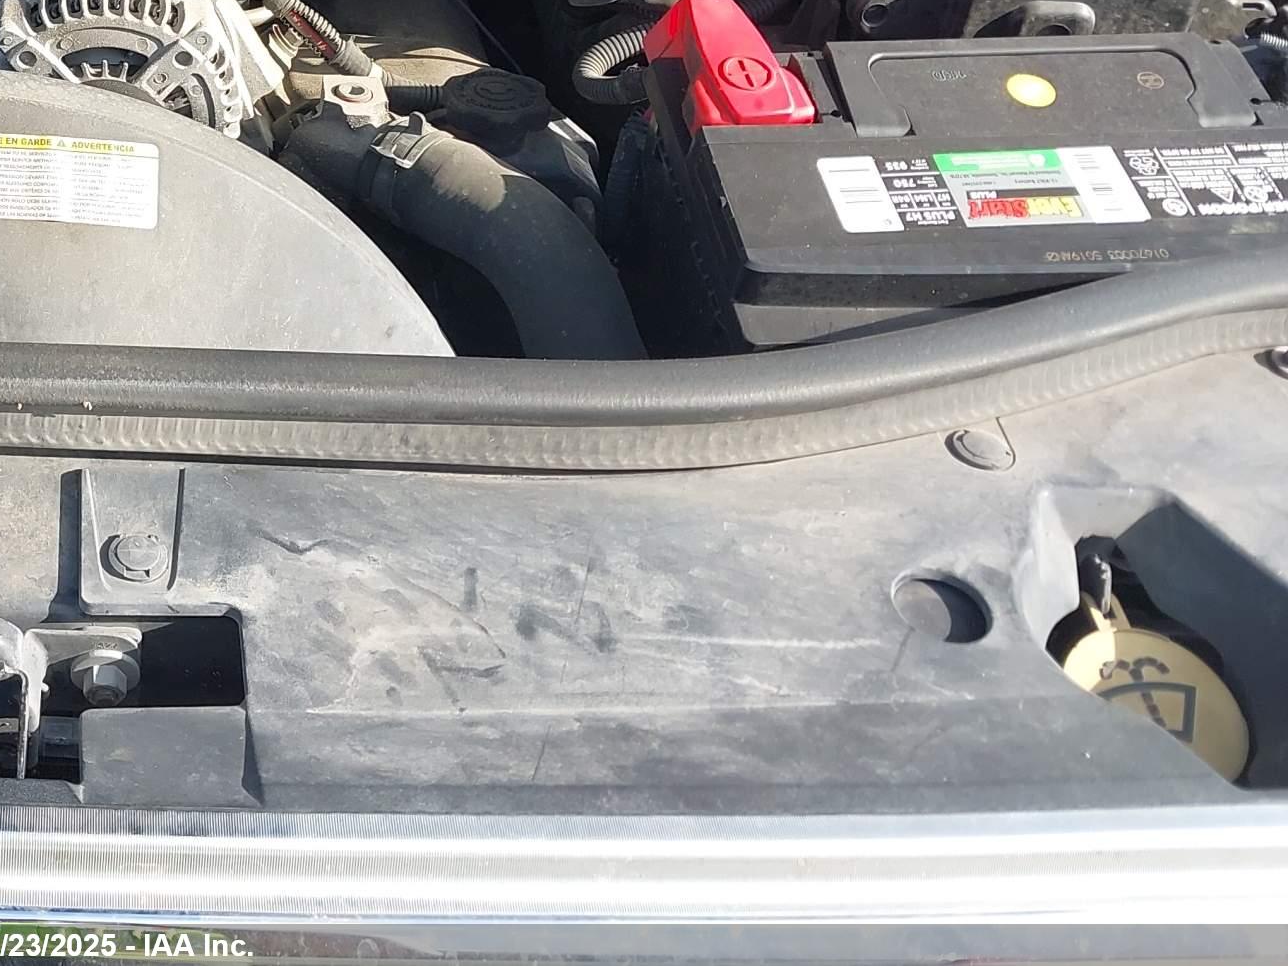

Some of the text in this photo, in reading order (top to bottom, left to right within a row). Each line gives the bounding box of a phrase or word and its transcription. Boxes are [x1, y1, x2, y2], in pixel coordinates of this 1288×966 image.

[5, 137, 18, 145] EN
[20, 137, 53, 146] GARDE
[71, 141, 135, 153] ADVERTENCIA
[970, 190, 996, 199] PLUS
[968, 196, 1084, 220] EverStart
[923, 210, 956, 220] PLUS
